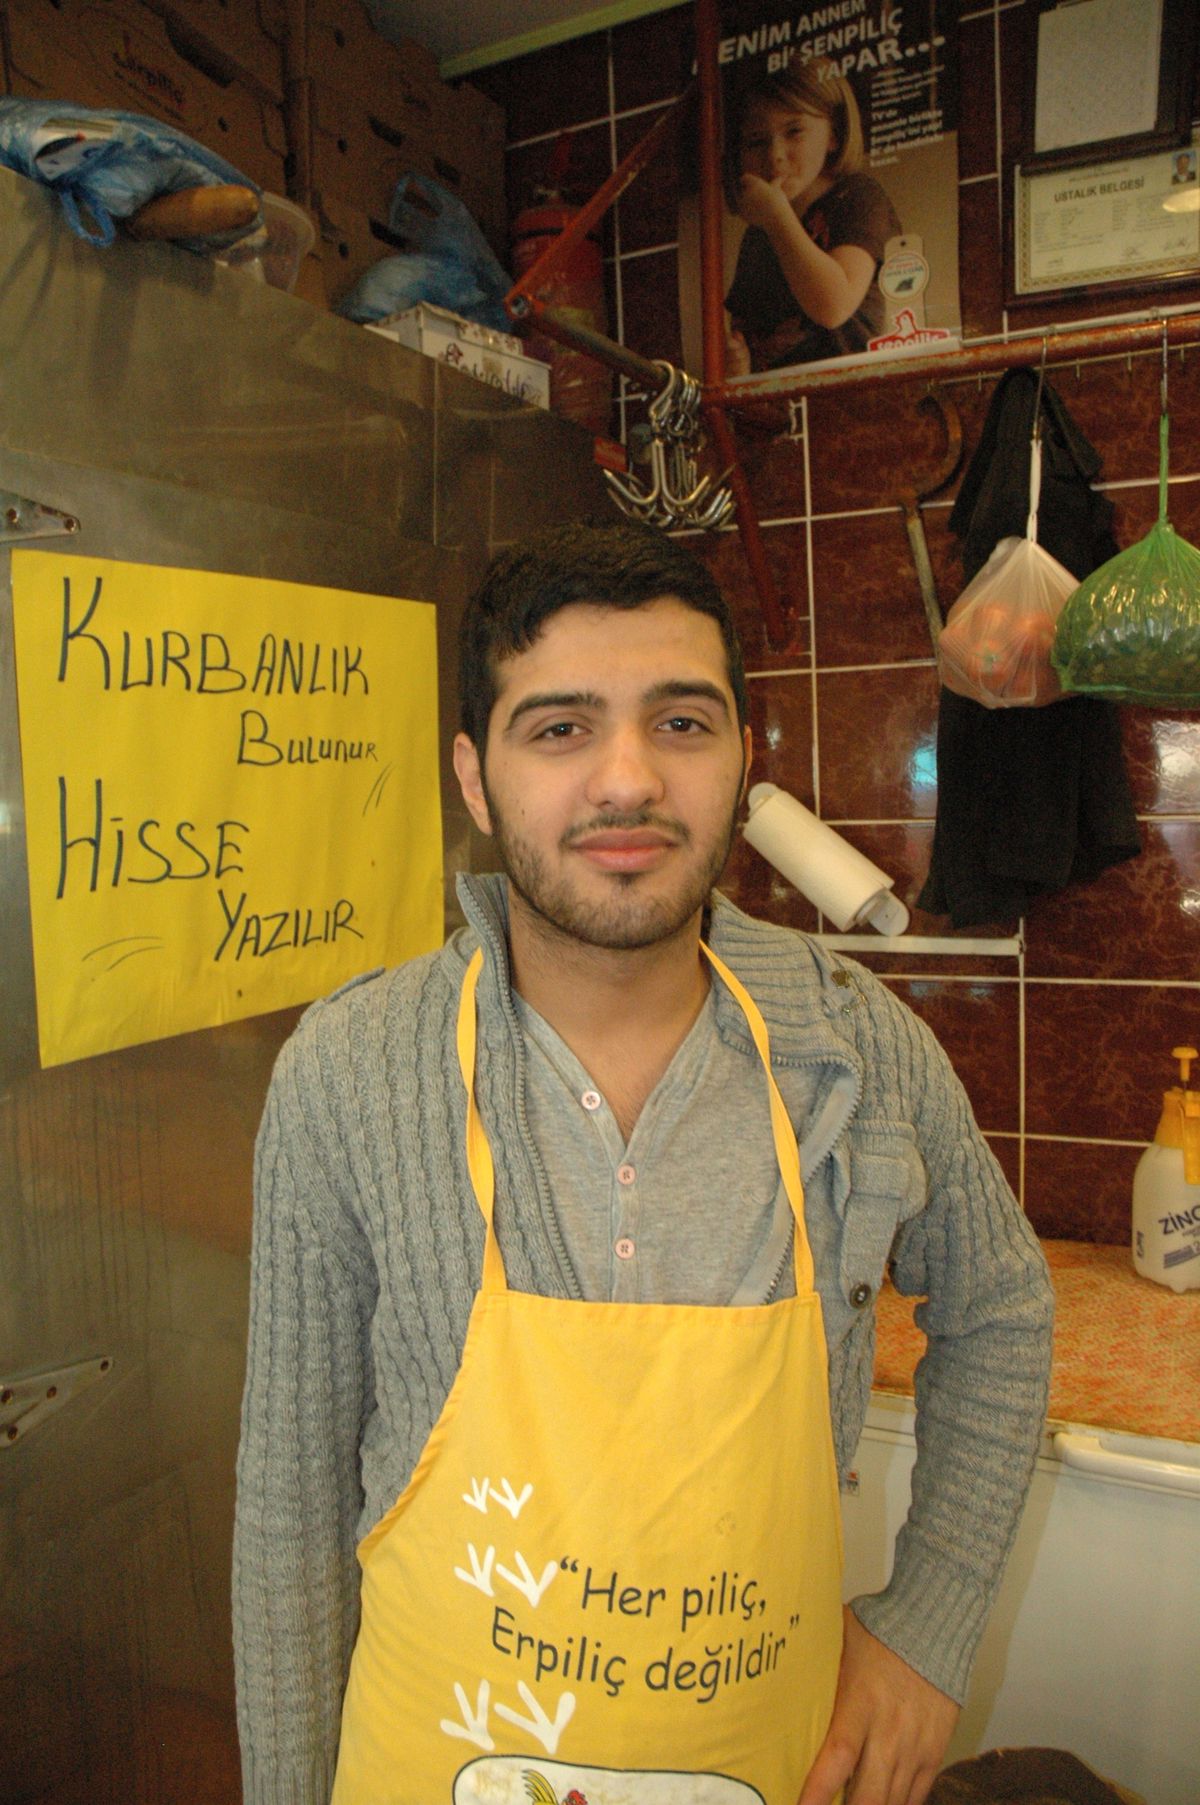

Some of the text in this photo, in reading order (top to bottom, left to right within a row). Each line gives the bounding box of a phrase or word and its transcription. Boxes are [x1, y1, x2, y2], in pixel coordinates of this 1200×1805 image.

[692, 0, 866, 75] ENİM ANNEM
[800, 7, 903, 63] ŞENPİLİÇ
[1054, 176, 1144, 203] USTALIK BELGESİ
[58, 577, 369, 696] KURBANLIK
[214, 889, 364, 962] YAZILIR
[681, 1571, 767, 1632] piliç,
[491, 1606, 626, 1696] Erpiliç
